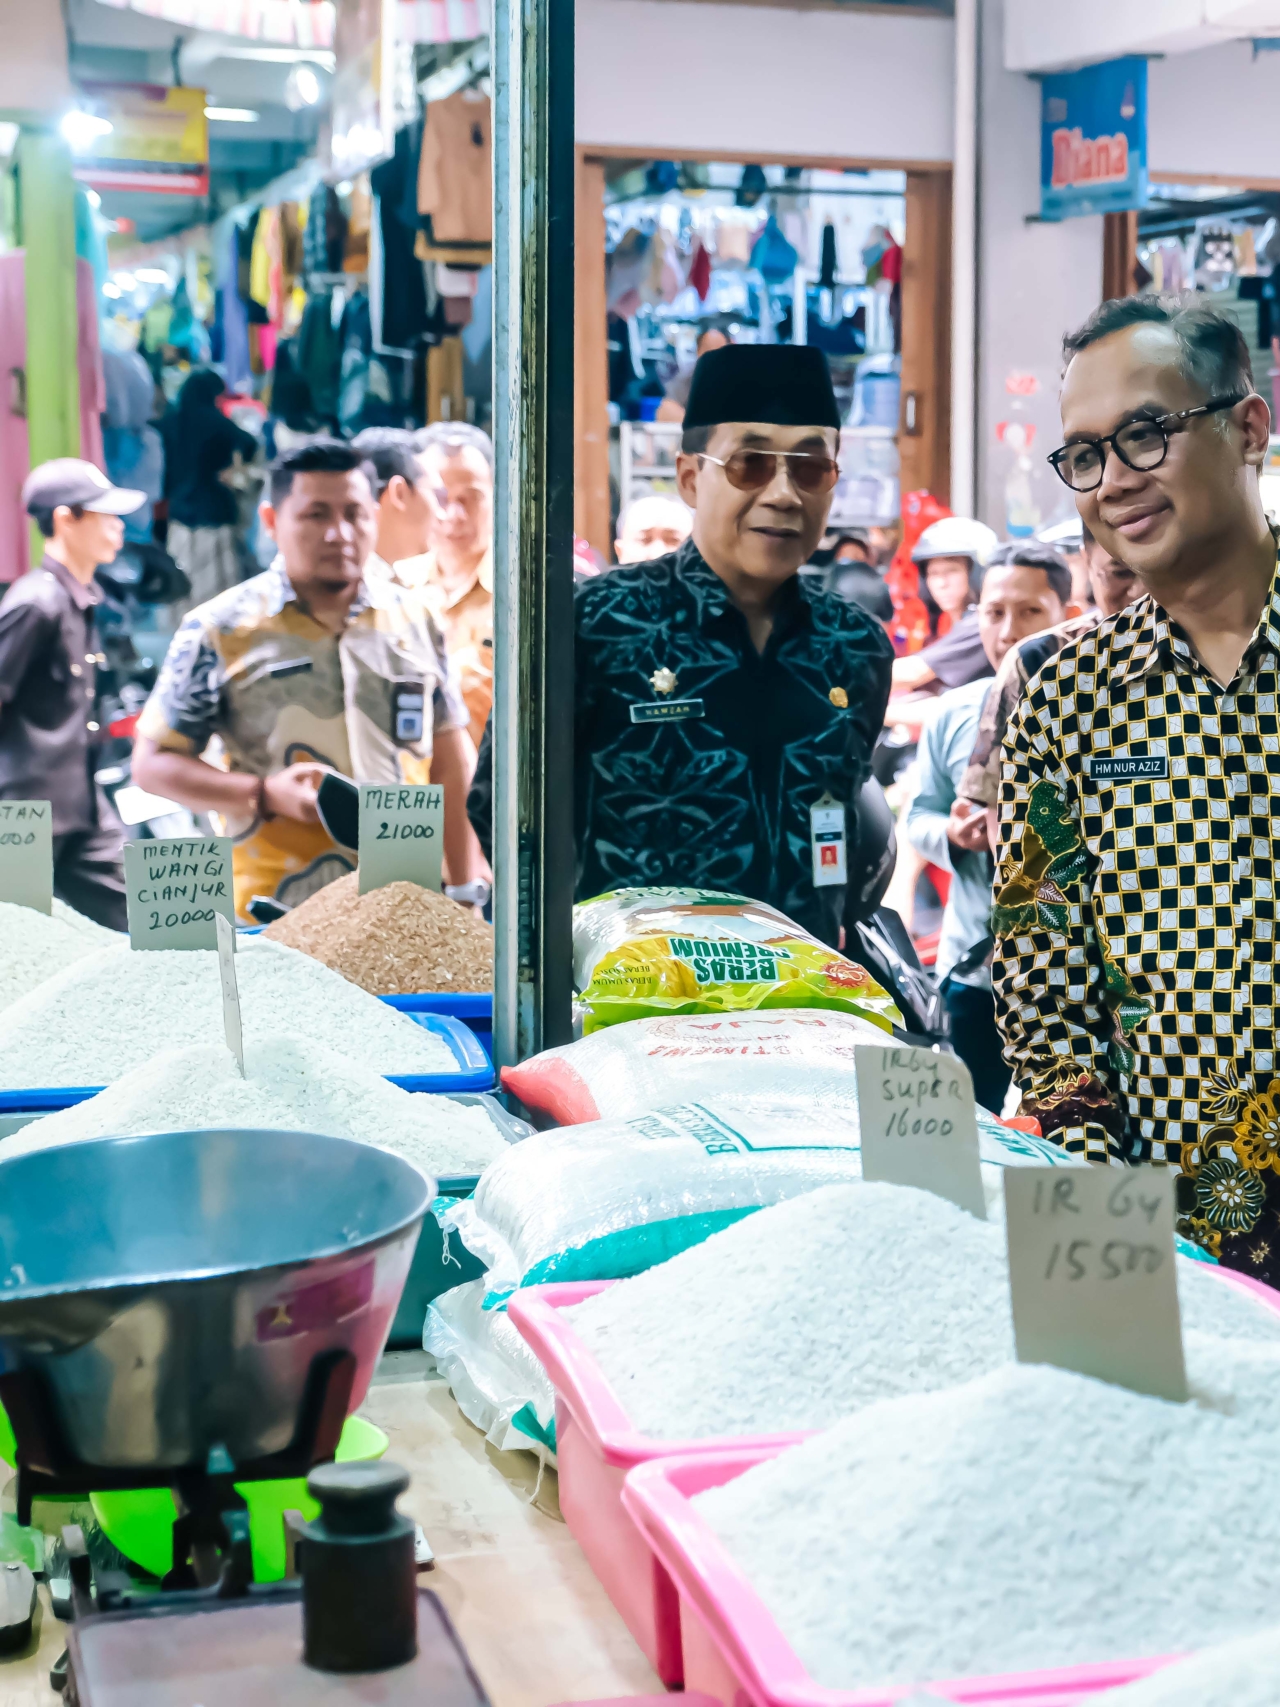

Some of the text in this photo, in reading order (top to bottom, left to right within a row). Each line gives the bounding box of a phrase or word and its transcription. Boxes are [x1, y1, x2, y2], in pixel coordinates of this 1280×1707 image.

[1052, 126, 1128, 189] Diana
[1095, 761, 1161, 774] HM NUR AZIZ
[365, 789, 441, 810] MERAH
[0, 805, 45, 820] TAN
[376, 822, 435, 840] 21000
[143, 842, 221, 860] MENTIK
[149, 908, 216, 930] 20000
[693, 957, 777, 982] BERAS
[886, 1107, 953, 1137] 16000
[1033, 1171, 1162, 1225] IR 64
[1044, 1238, 1165, 1282] 15500
